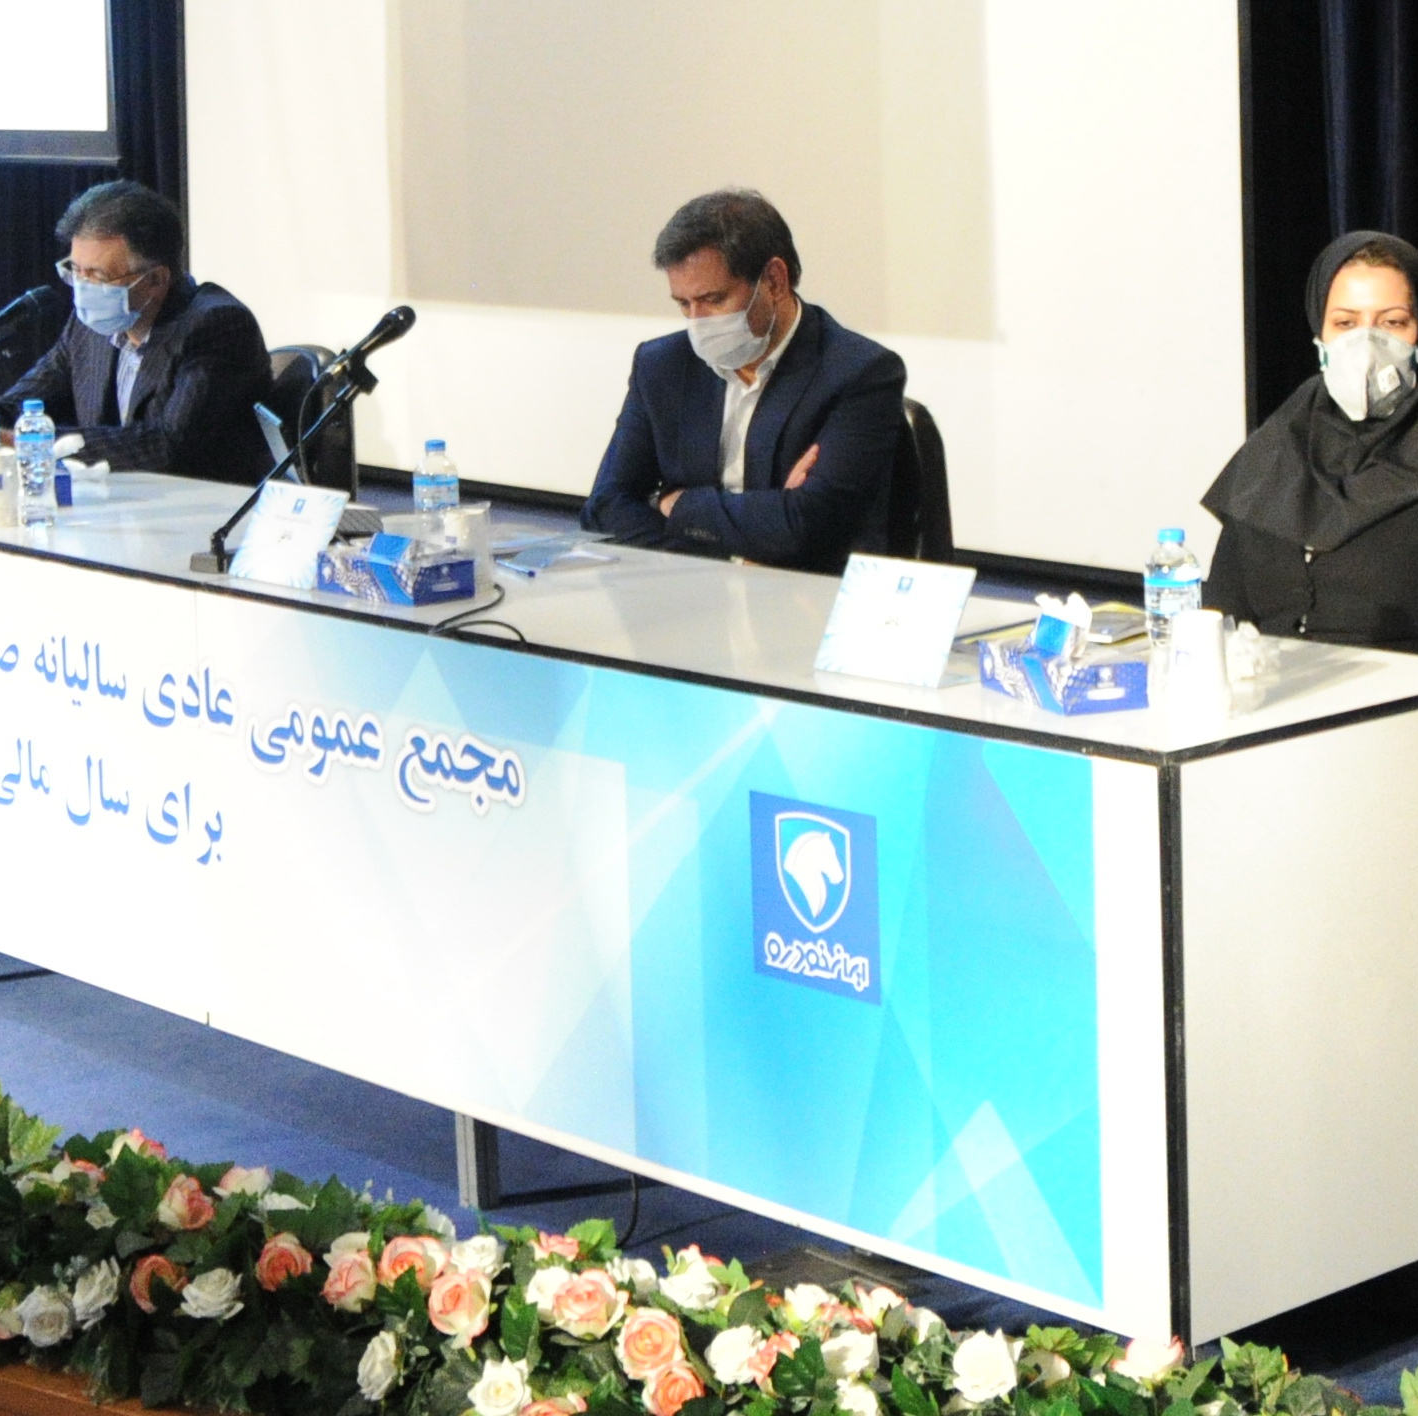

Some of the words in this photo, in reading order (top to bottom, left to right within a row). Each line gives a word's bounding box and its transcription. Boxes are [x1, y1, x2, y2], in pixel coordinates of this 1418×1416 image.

[34, 636, 126, 706] سالیانه
[143, 667, 234, 727] عادی
[251, 710, 381, 777] عمومی
[399, 736, 522, 806] مجمع
[65, 755, 130, 826] سال
[145, 782, 223, 865] برای
